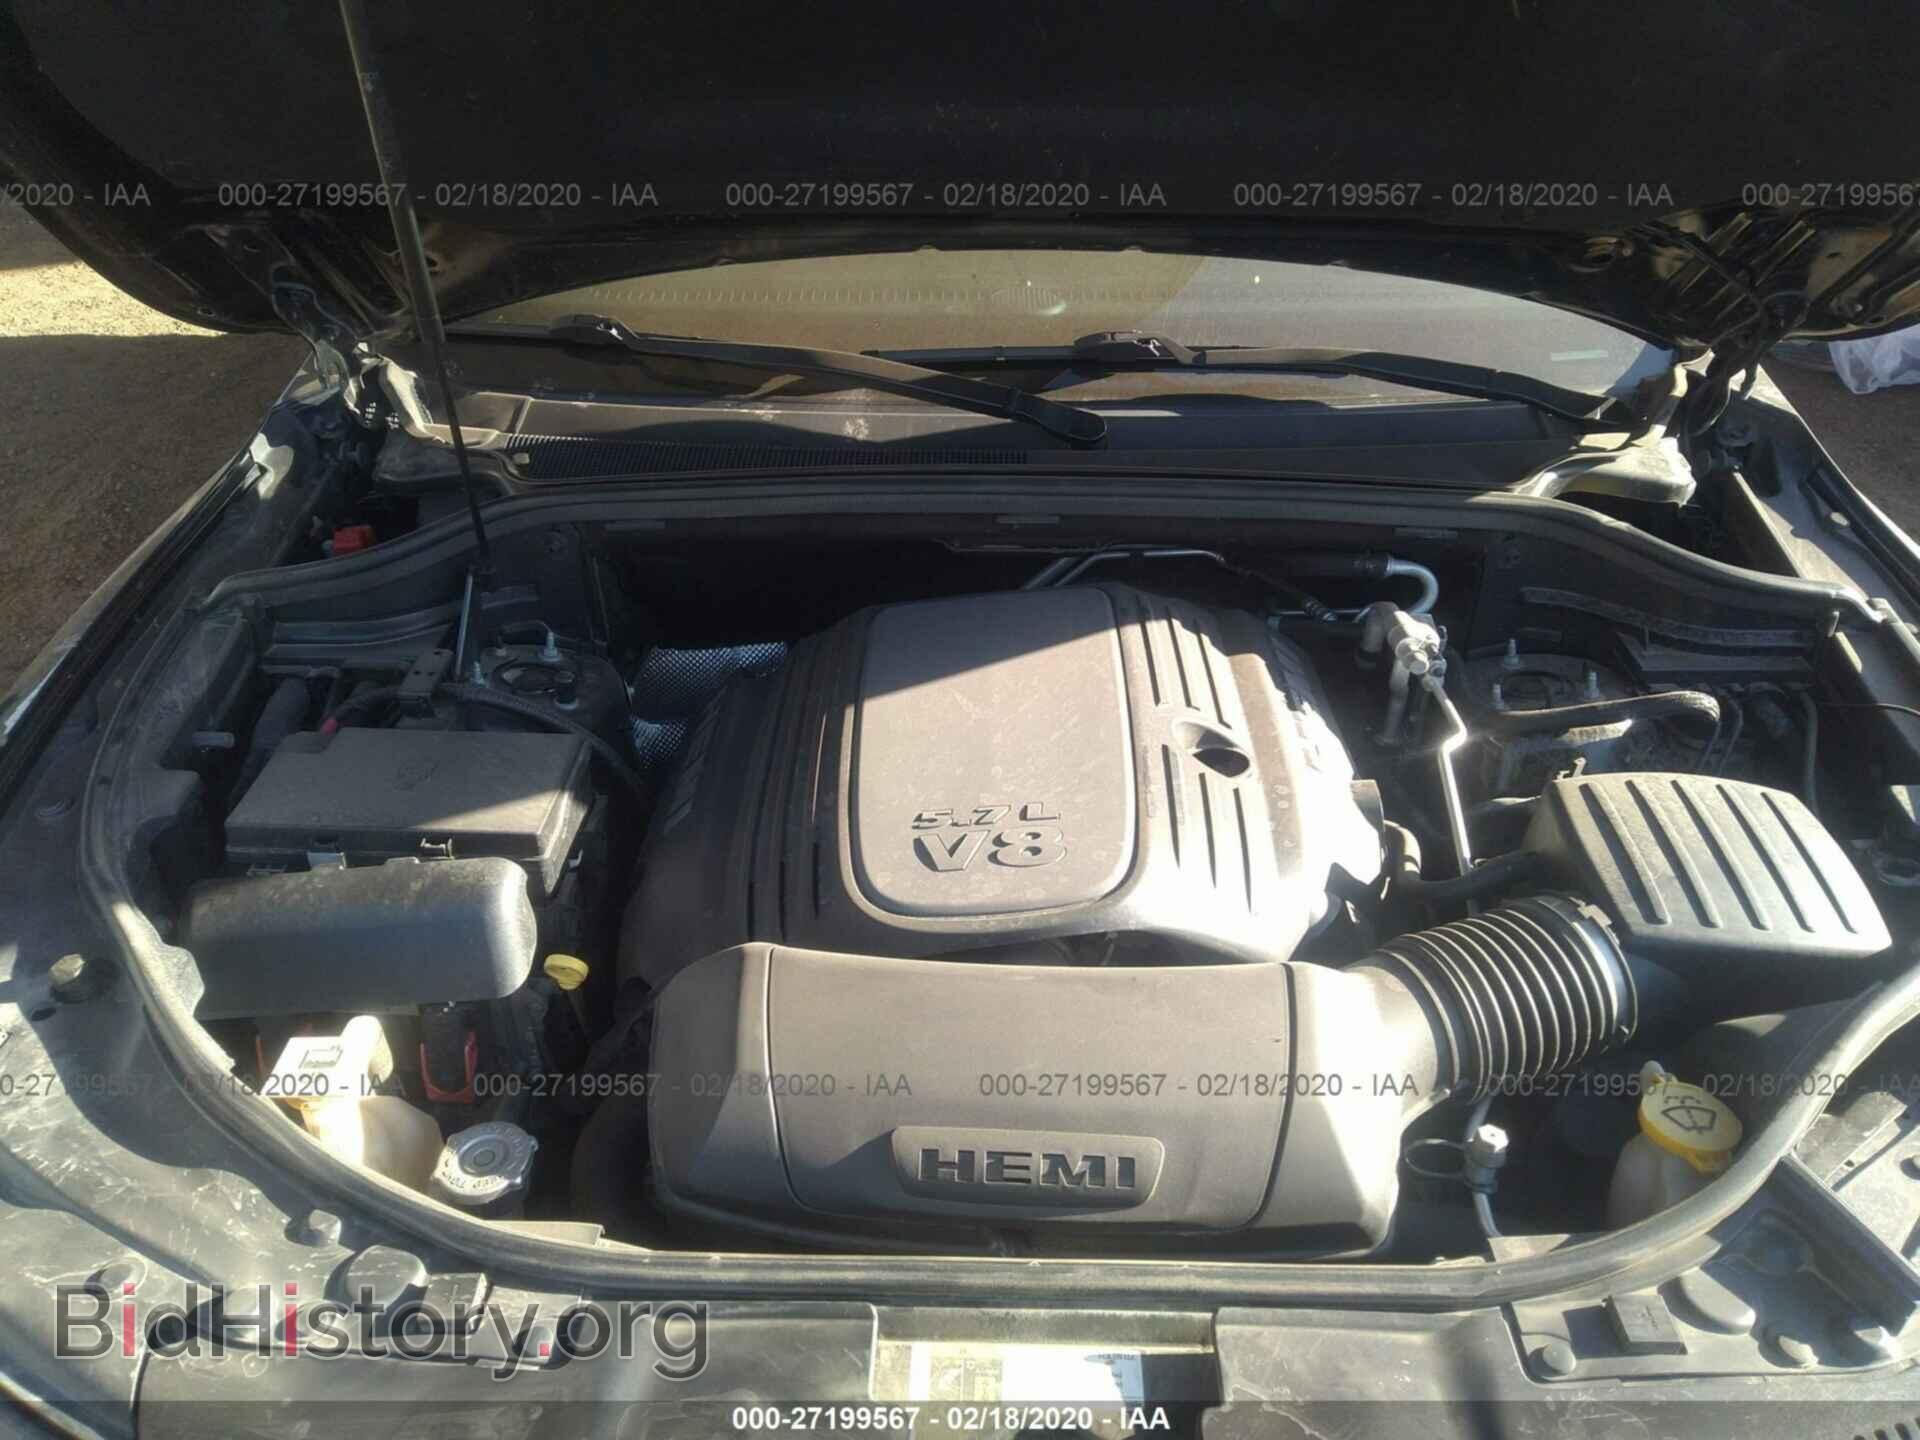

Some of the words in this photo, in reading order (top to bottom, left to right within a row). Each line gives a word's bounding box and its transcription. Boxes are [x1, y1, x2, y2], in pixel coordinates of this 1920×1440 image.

[912, 802, 1061, 830] 5.7L
[912, 825, 1068, 873] V8
[918, 1148, 1136, 1189] HEMI
